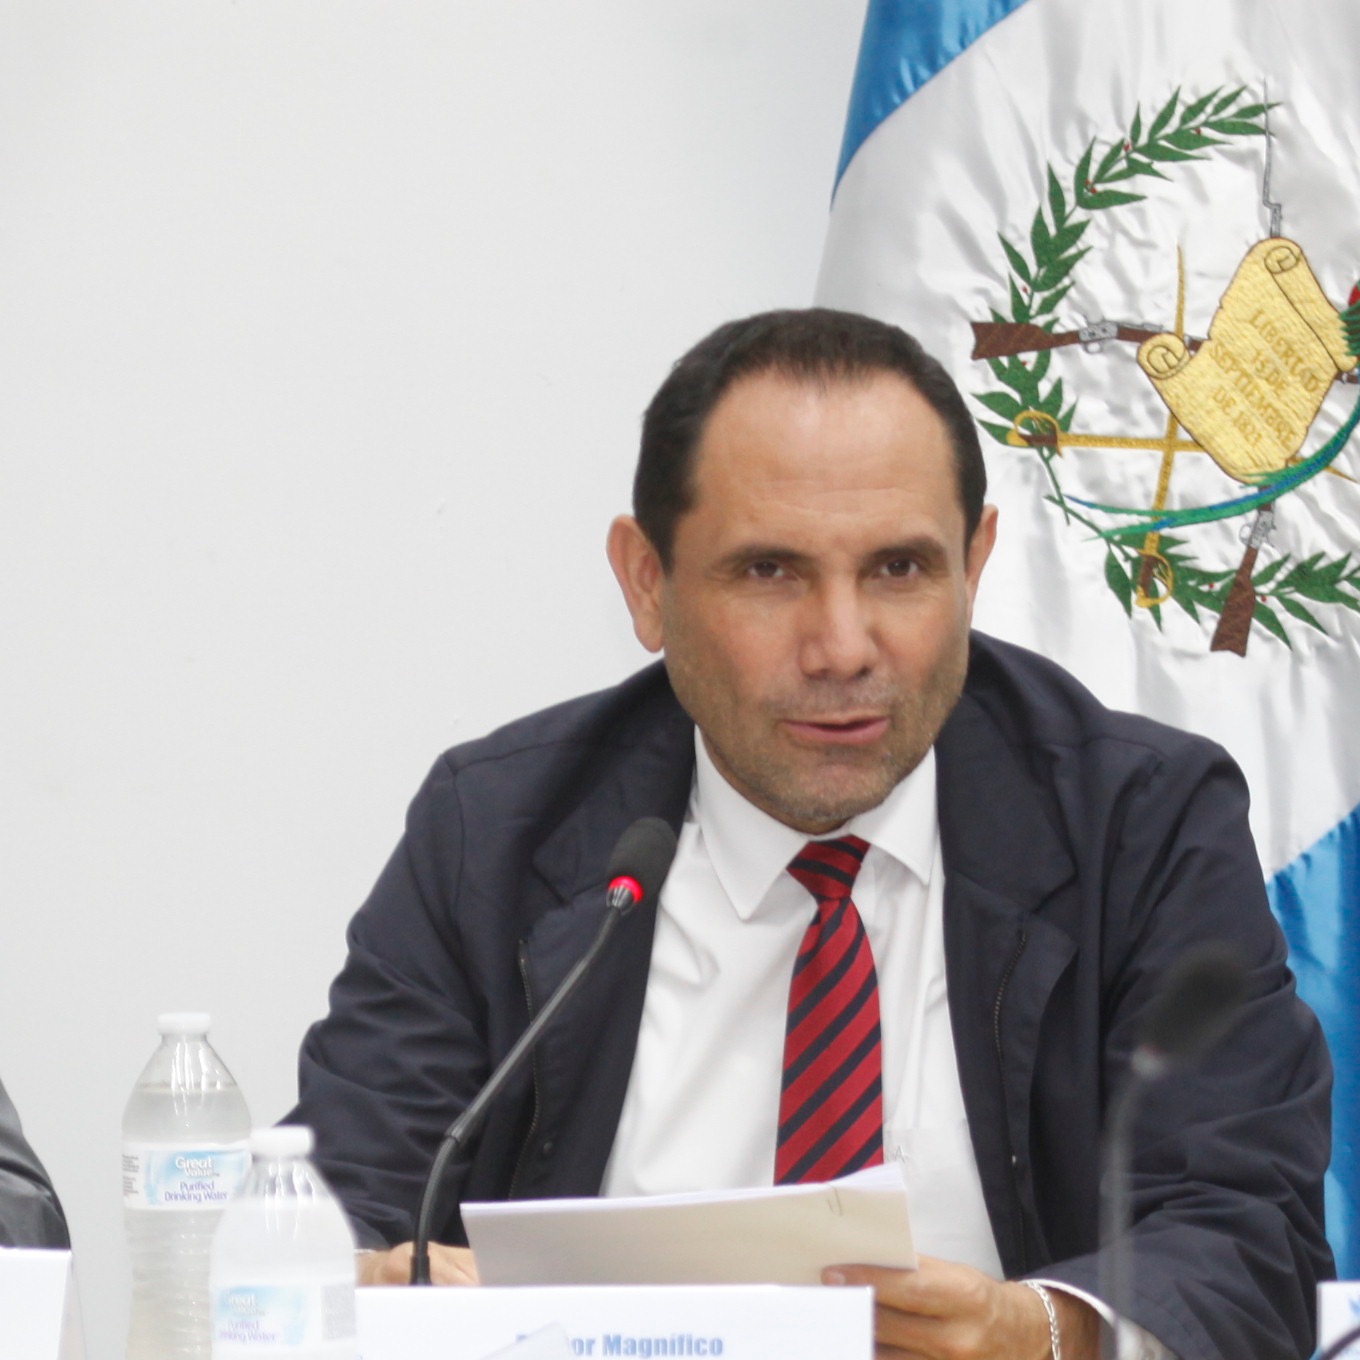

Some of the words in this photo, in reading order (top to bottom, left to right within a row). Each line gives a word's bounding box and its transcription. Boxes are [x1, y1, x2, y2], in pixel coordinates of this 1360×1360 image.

[175, 1156, 212, 1169] Great
[179, 1181, 215, 1192] Purified
[164, 1192, 202, 1202] Drinking
[203, 1192, 228, 1201] Water
[602, 1334, 724, 1360] Magnífico
